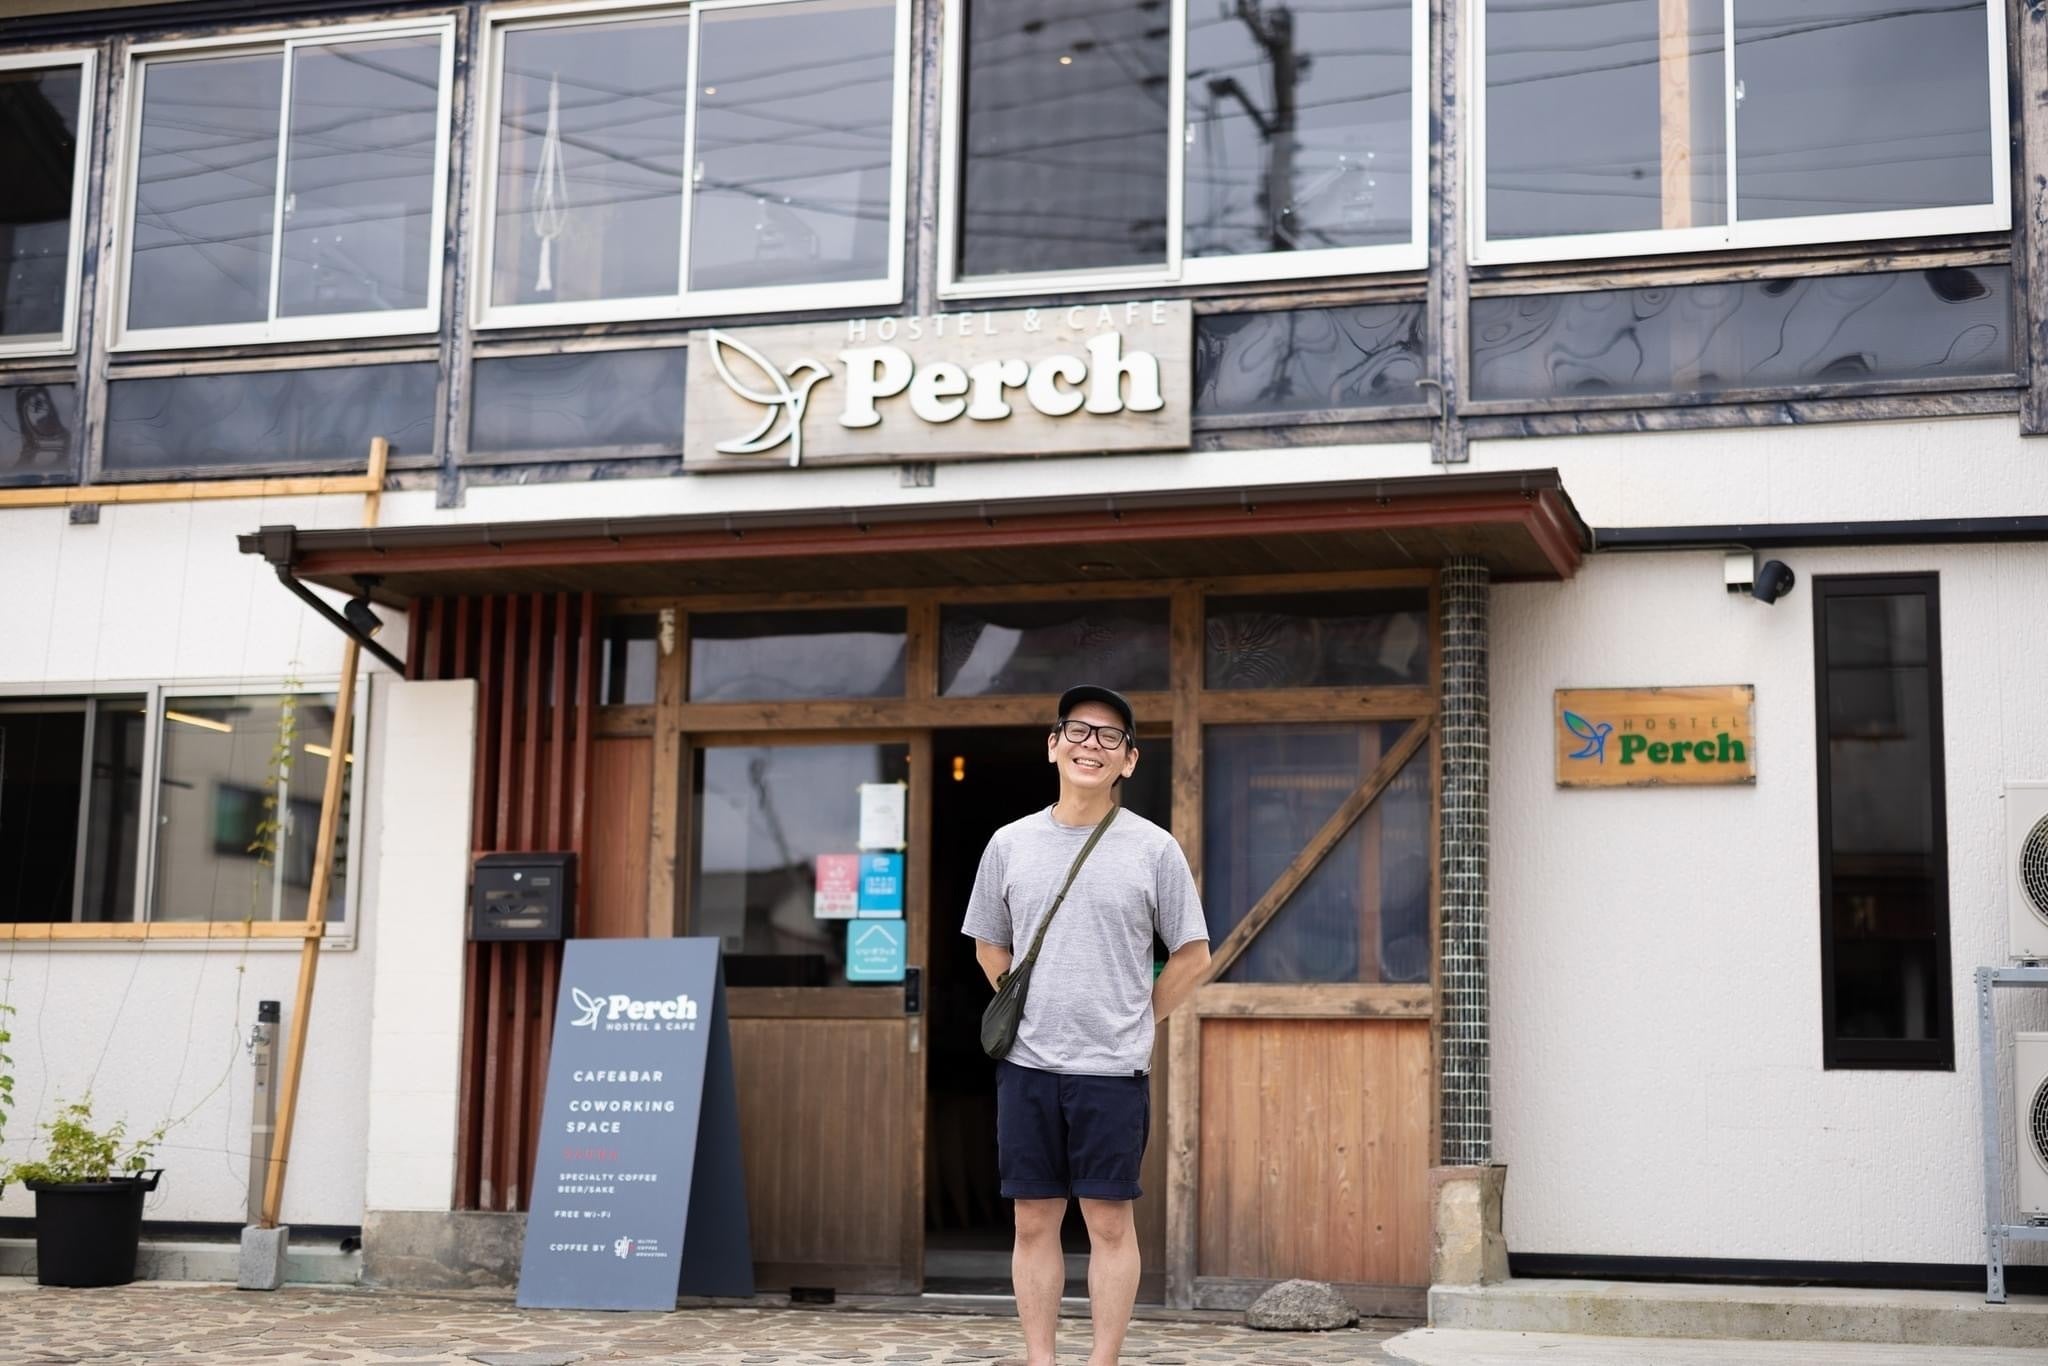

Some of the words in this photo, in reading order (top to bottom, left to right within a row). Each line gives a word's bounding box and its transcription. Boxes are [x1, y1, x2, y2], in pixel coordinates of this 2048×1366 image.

[847, 312, 1000, 342] HOSTEL
[1022, 307, 1044, 332] &
[1067, 299, 1168, 331] CAFE
[838, 331, 1166, 430] Perch
[1623, 716, 1739, 731] HOSTEL
[1618, 732, 1747, 765] Perch
[606, 994, 698, 1021] Perch
[606, 1022, 650, 1032] HOSTEL
[666, 1021, 696, 1032] CAFE
[573, 1070, 664, 1083] CAFE&BAR
[568, 1100, 675, 1112] COWORKING
[566, 1121, 621, 1134] SPACE
[559, 1173, 615, 1182] SPECIALTY
[618, 1173, 658, 1183] COFFEE
[557, 1185, 615, 1195] BEER/SAKE
[554, 1210, 580, 1219] FREE
[549, 1243, 589, 1253] COFFEE
[592, 1243, 607, 1253] BY
